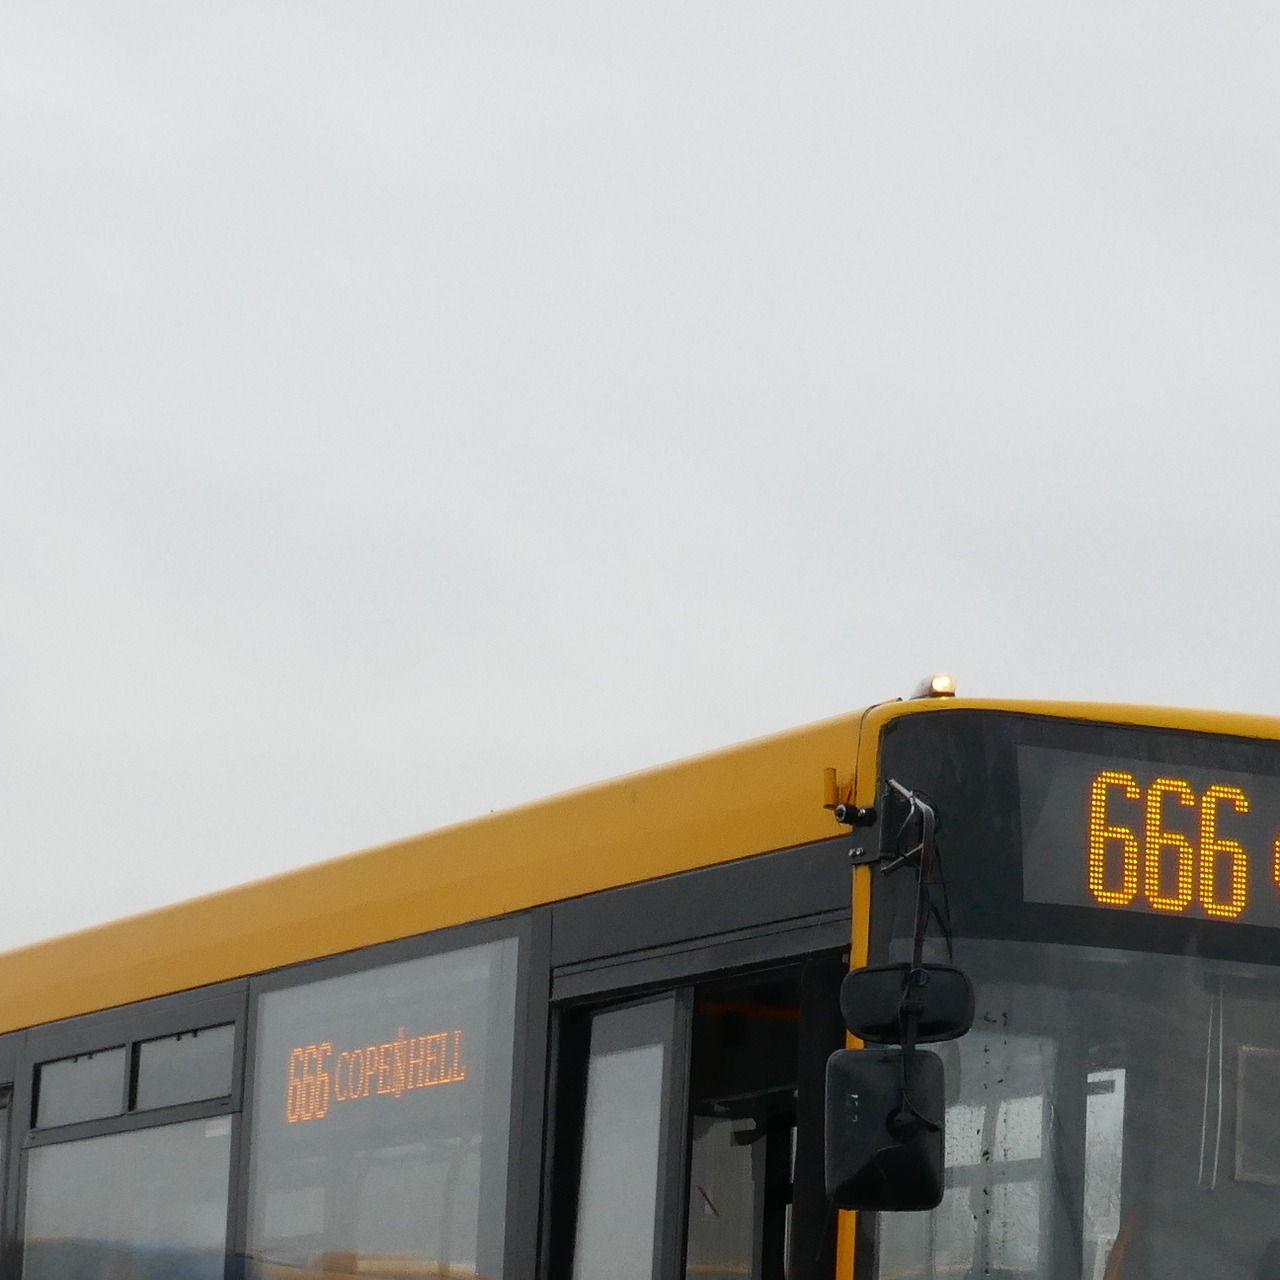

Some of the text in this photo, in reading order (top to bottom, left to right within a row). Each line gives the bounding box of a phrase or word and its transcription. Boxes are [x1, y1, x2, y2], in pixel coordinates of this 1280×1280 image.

[1088, 771, 1249, 918] 666
[286, 1026, 465, 1123] 666 COPENHELL
